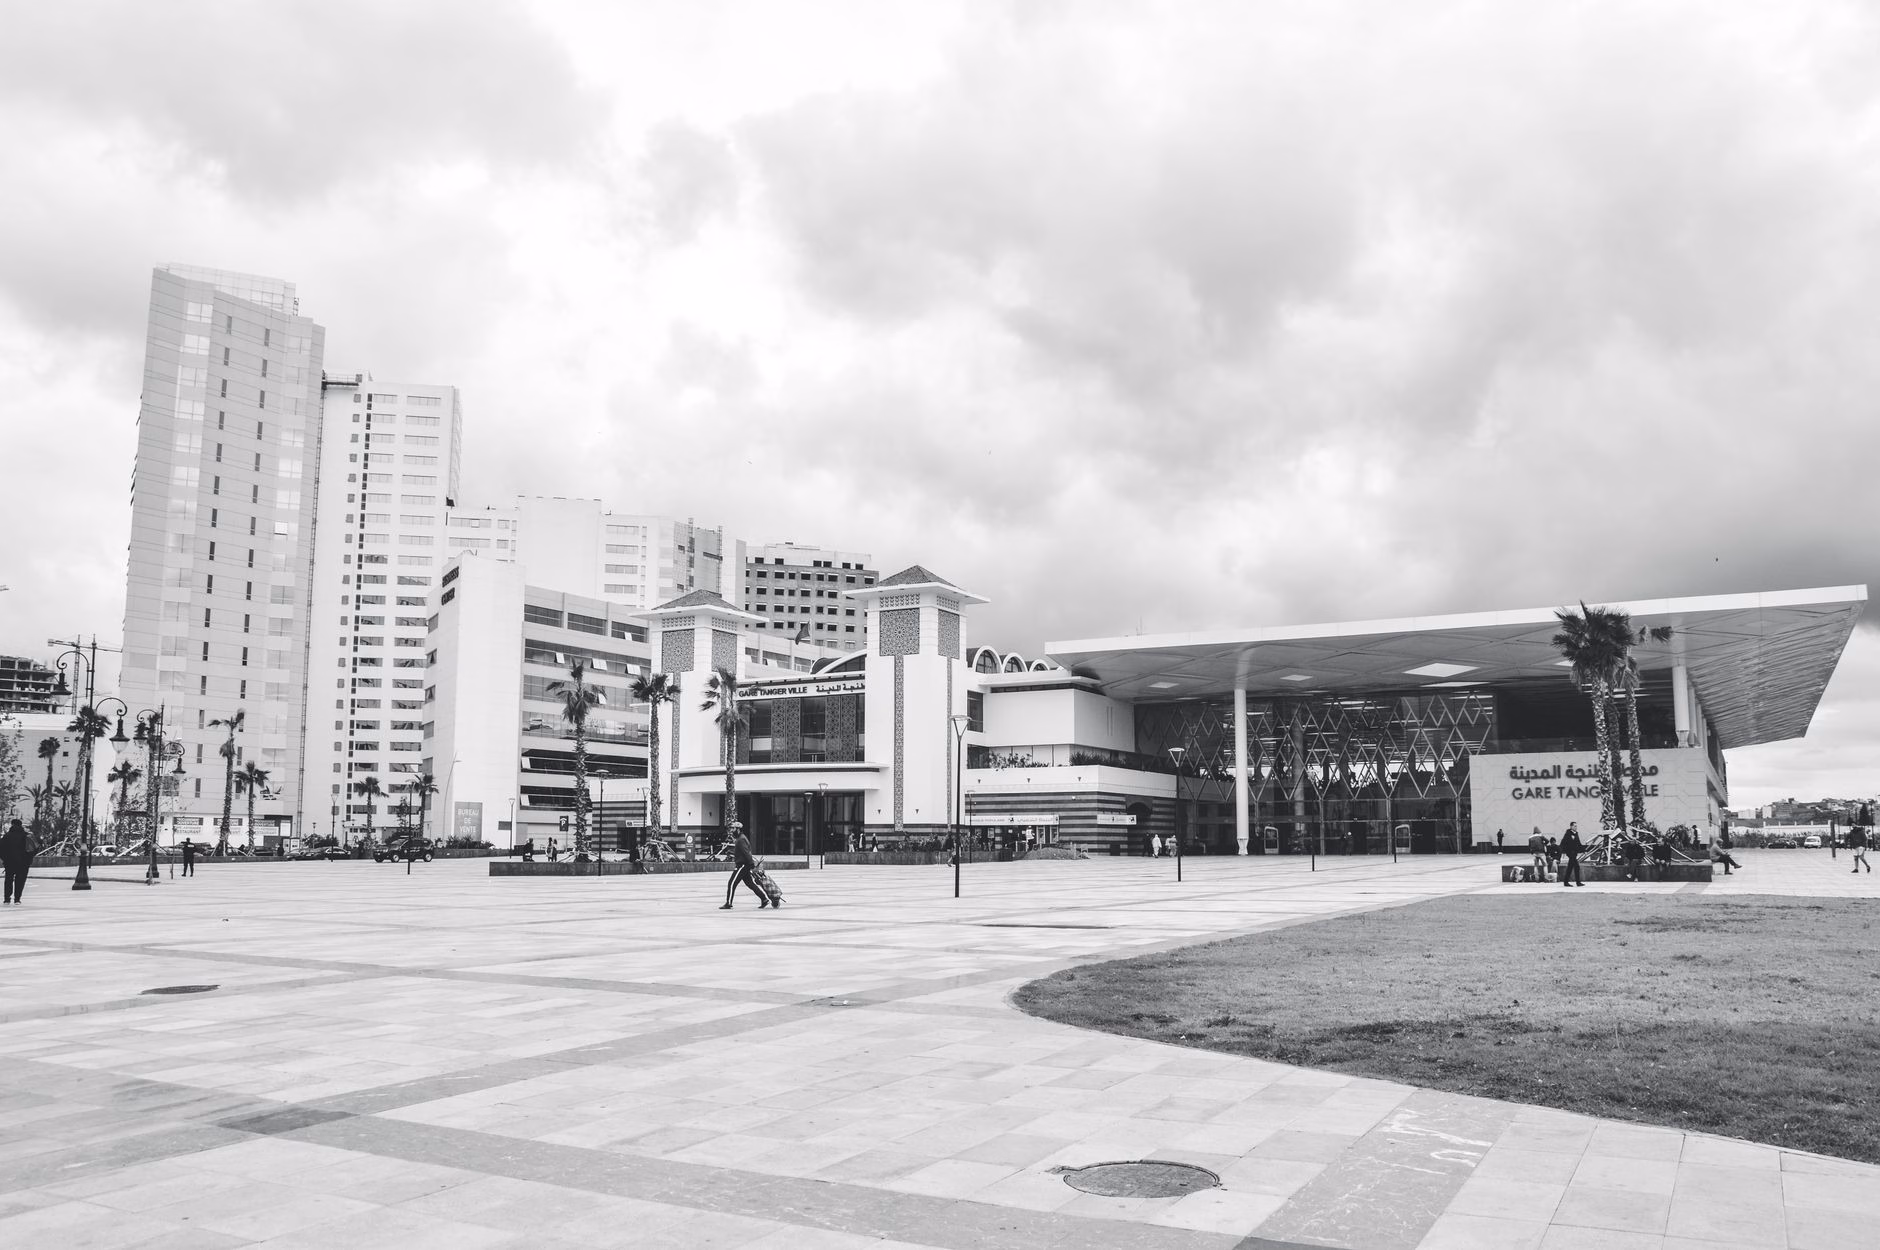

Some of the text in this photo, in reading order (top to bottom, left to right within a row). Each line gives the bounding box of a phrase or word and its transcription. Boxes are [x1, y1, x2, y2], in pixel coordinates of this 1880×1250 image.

[739, 686, 808, 697] GARE TANGER VILLE
[1509, 765, 1561, 783] المدينة
[1512, 787, 1552, 800] GARE
